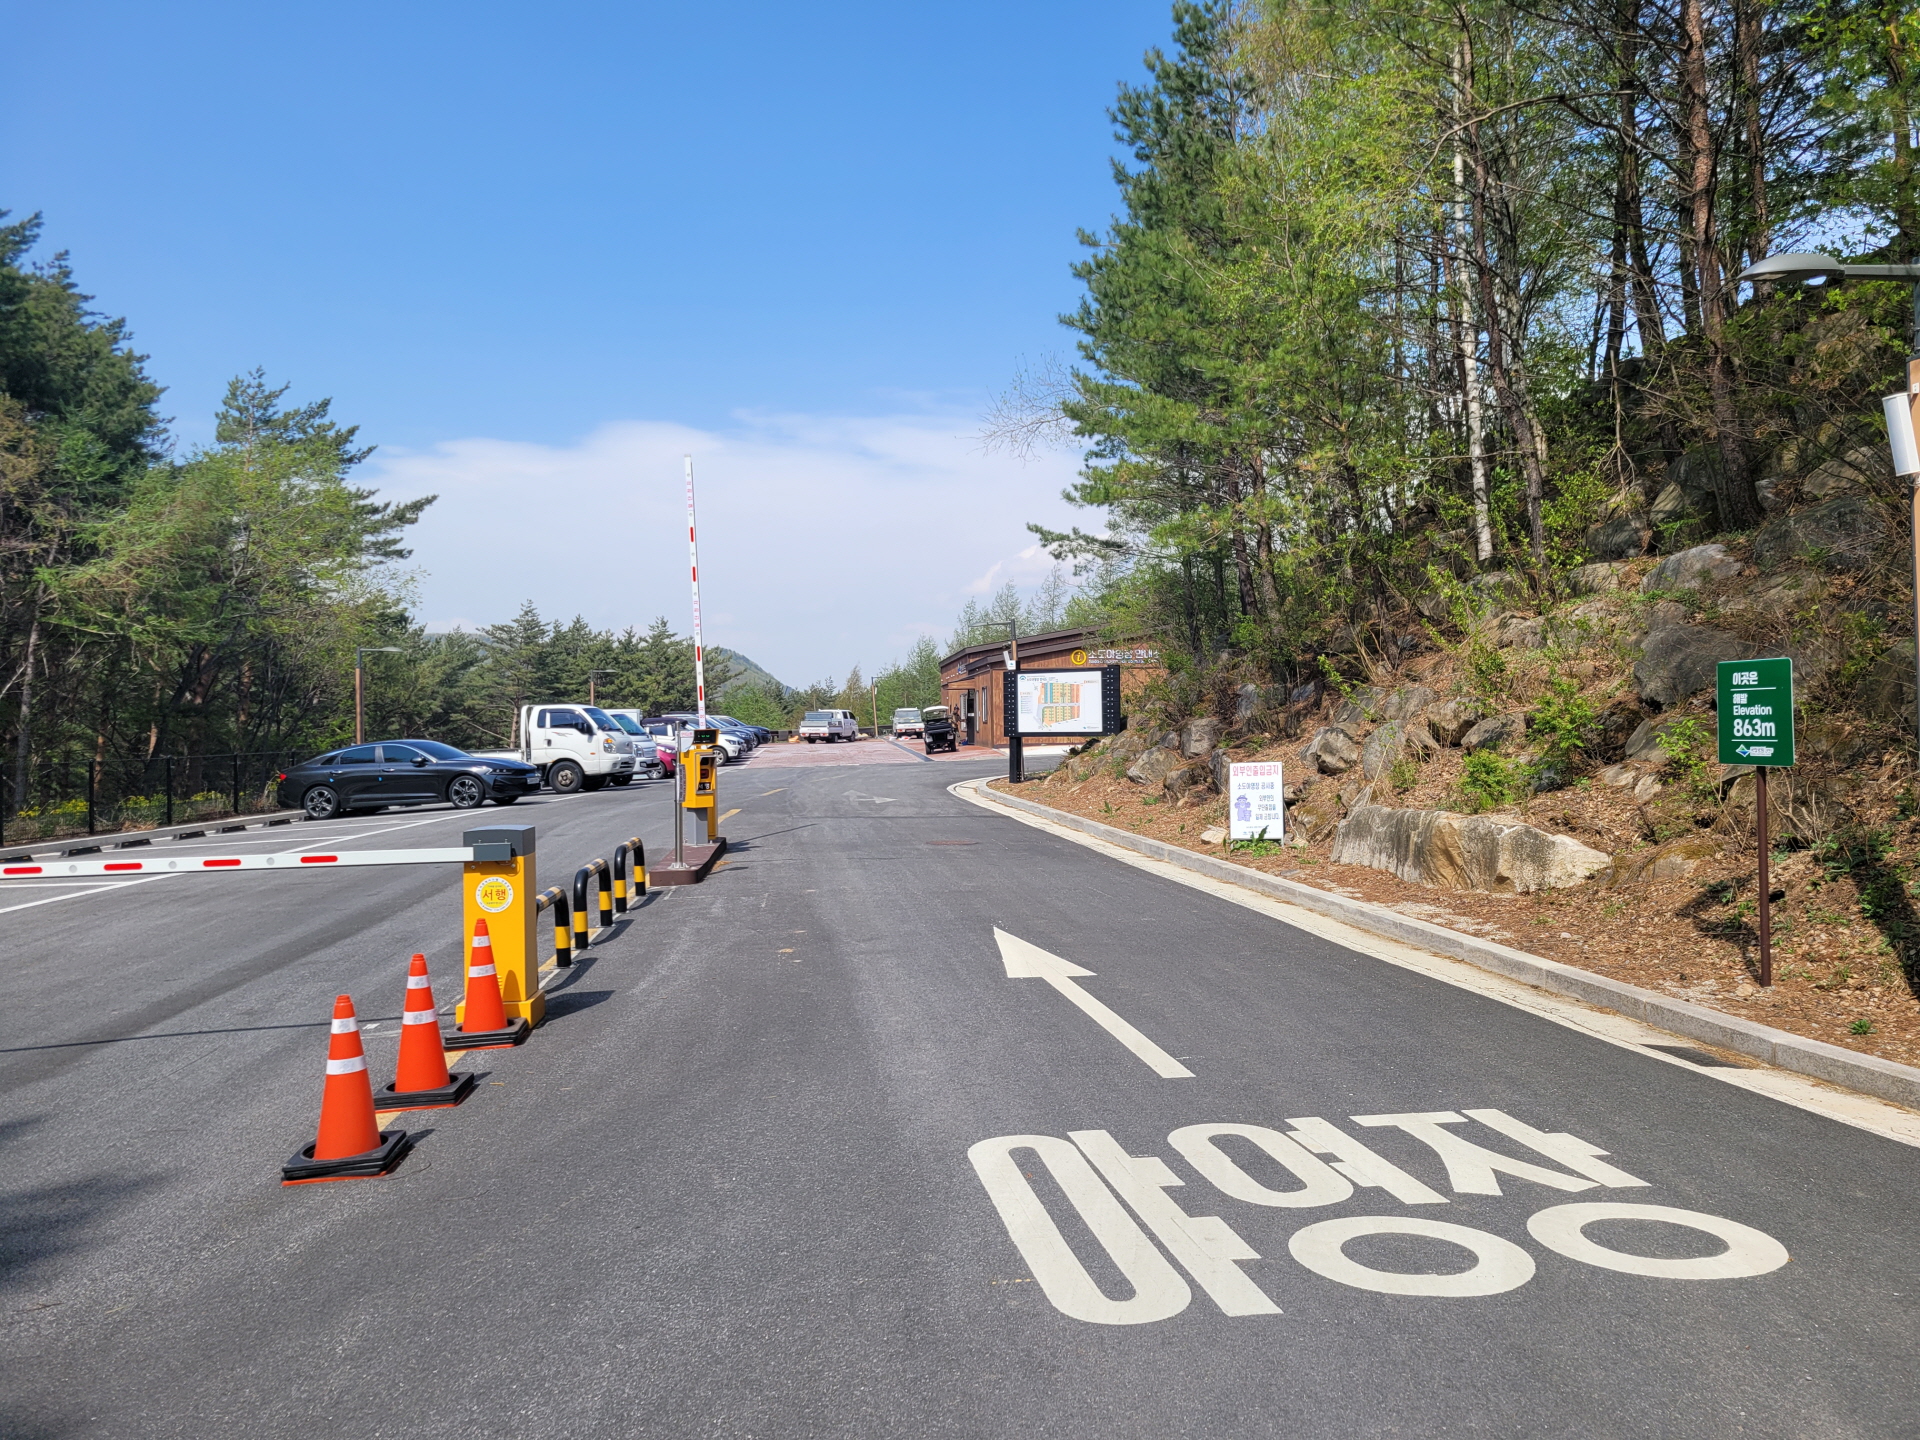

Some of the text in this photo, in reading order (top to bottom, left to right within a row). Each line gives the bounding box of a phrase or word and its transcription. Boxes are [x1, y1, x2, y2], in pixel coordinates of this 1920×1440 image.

[1732, 671, 1759, 685] 이곳은
[1732, 693, 1748, 704] 해발
[1733, 704, 1772, 716] Elevation
[1733, 718, 1776, 737] 863m
[1233, 765, 1278, 776] 외부인출입금지
[483, 889, 506, 901] 서행
[967, 1108, 1790, 1325] 야영장
